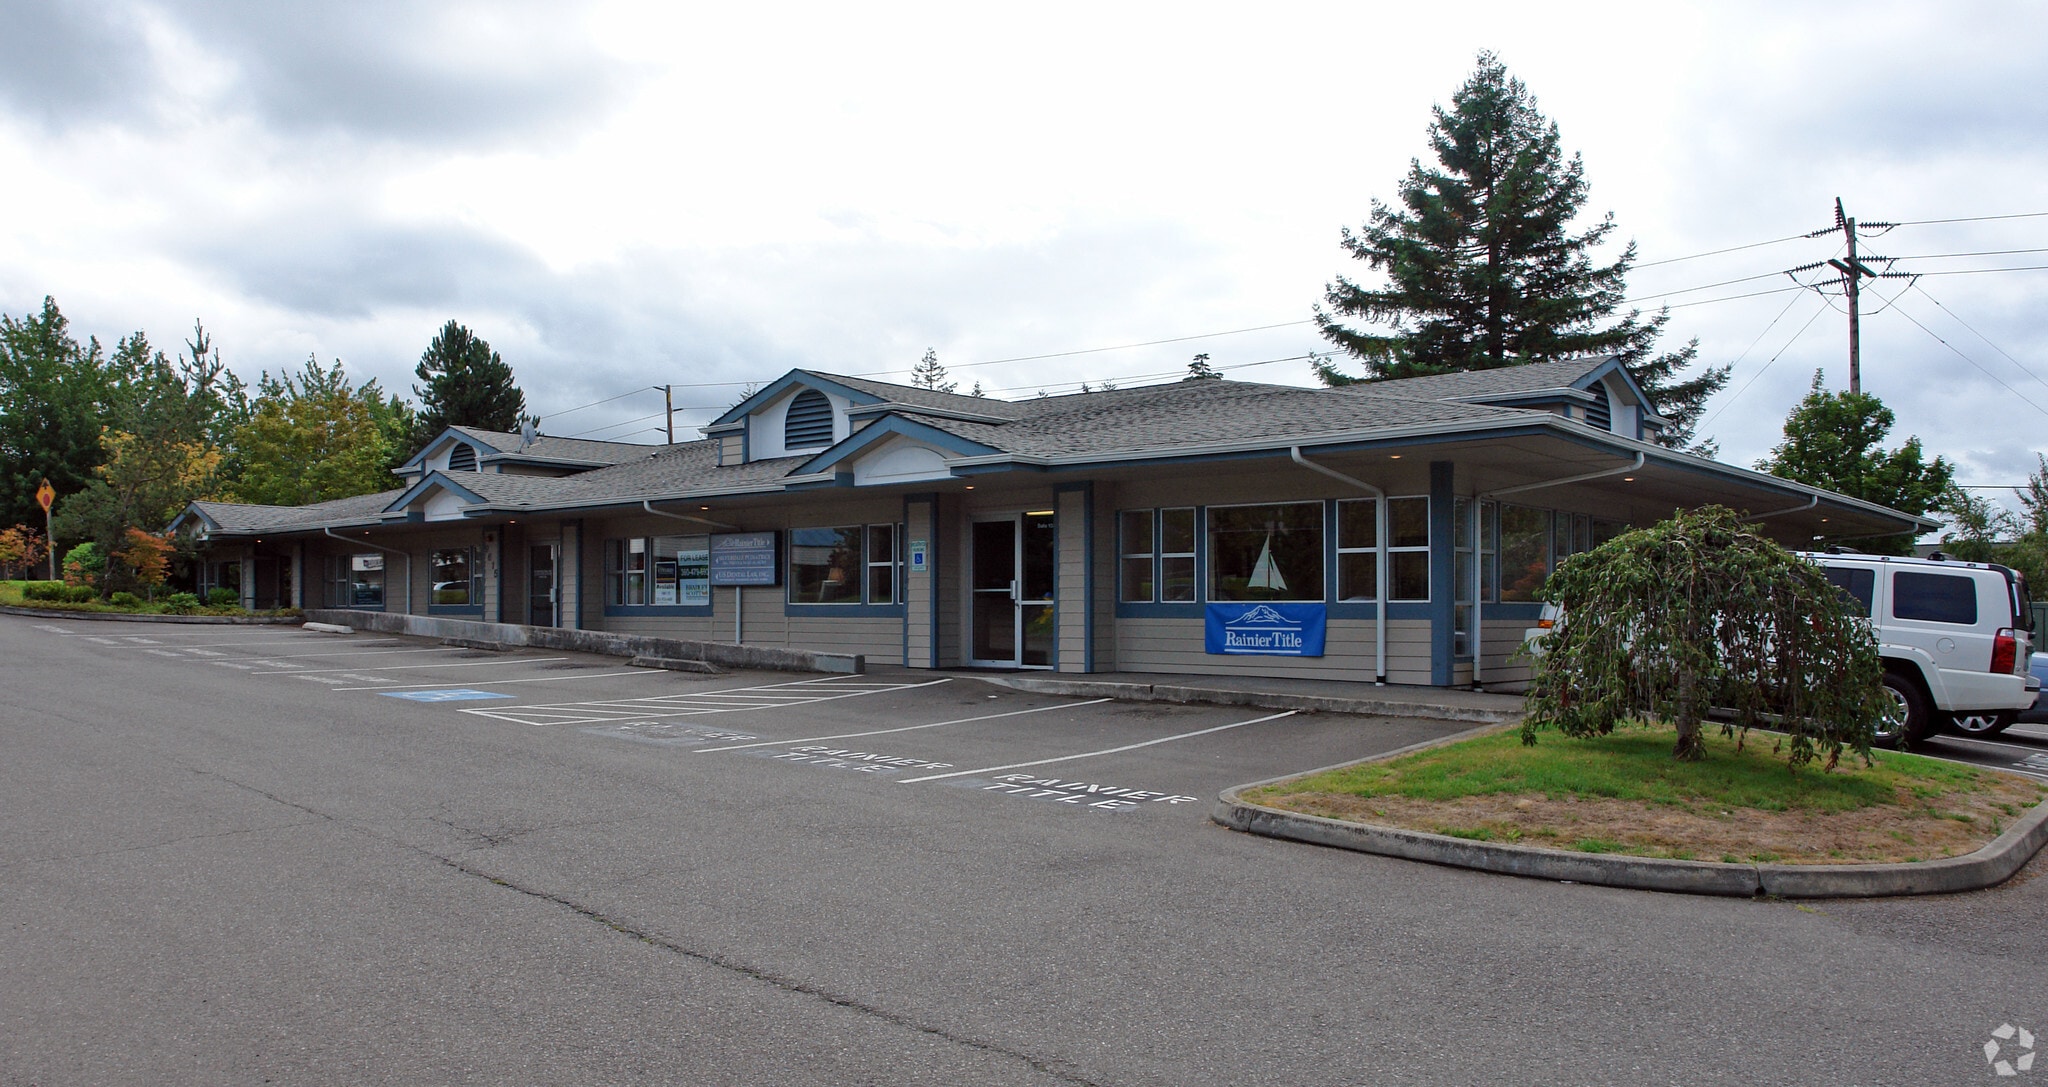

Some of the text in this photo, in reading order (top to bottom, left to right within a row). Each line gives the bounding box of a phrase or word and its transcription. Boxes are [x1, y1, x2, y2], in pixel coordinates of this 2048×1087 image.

[692, 553, 708, 561] LEASE
[1225, 631, 1302, 648] Rainier Title
[772, 753, 896, 772] TITLE
[790, 746, 954, 769] RAINIER
[982, 782, 1135, 809] TITLE
[992, 774, 1199, 804] RAINIER
